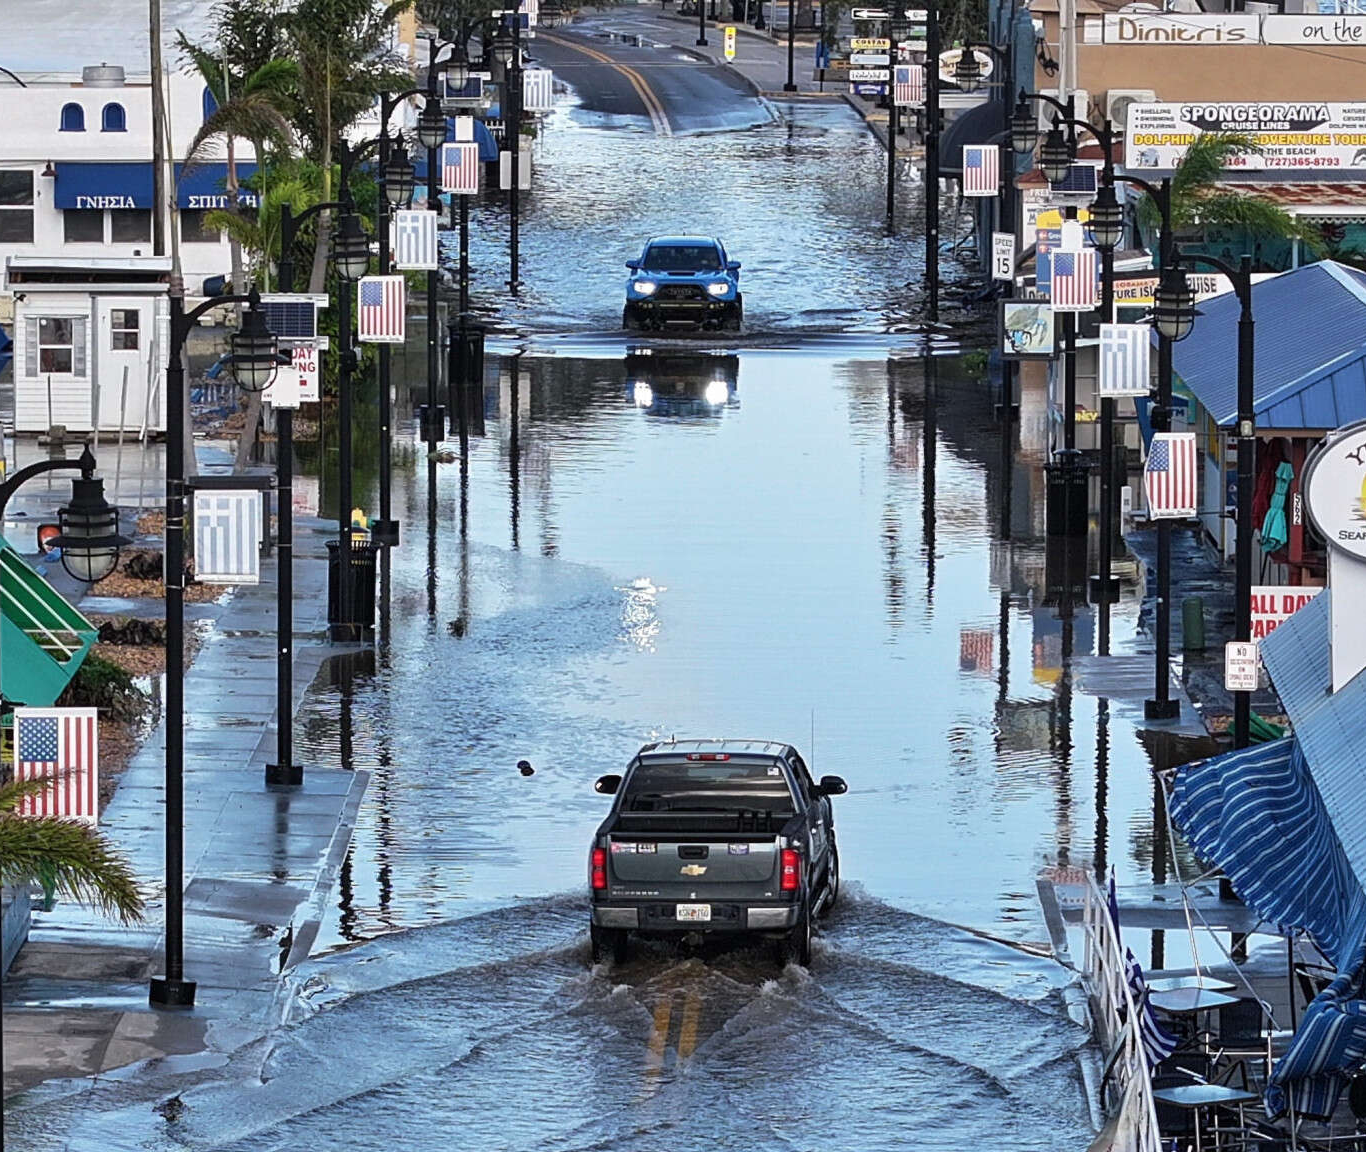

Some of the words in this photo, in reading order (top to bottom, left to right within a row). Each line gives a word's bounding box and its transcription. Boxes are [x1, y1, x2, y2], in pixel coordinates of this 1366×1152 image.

[1118, 16, 1247, 42] Dimitri's
[1302, 23, 1327, 42] on
[1334, 19, 1363, 42] the
[1180, 105, 1332, 122] SPONGEORAMA
[1221, 121, 1258, 131] CRUISE
[1260, 121, 1291, 131] LINES
[1134, 133, 1195, 146] DOLPHIN
[1285, 147, 1317, 156] BEACH
[1264, 157, 1340, 167] (727)365-8793
[995, 238, 1013, 247] SPEED
[996, 248, 1011, 256] LIMIT
[996, 257, 1010, 275] 15
[1249, 595, 1277, 615] ALL
[1237, 647, 1248, 657] NO
